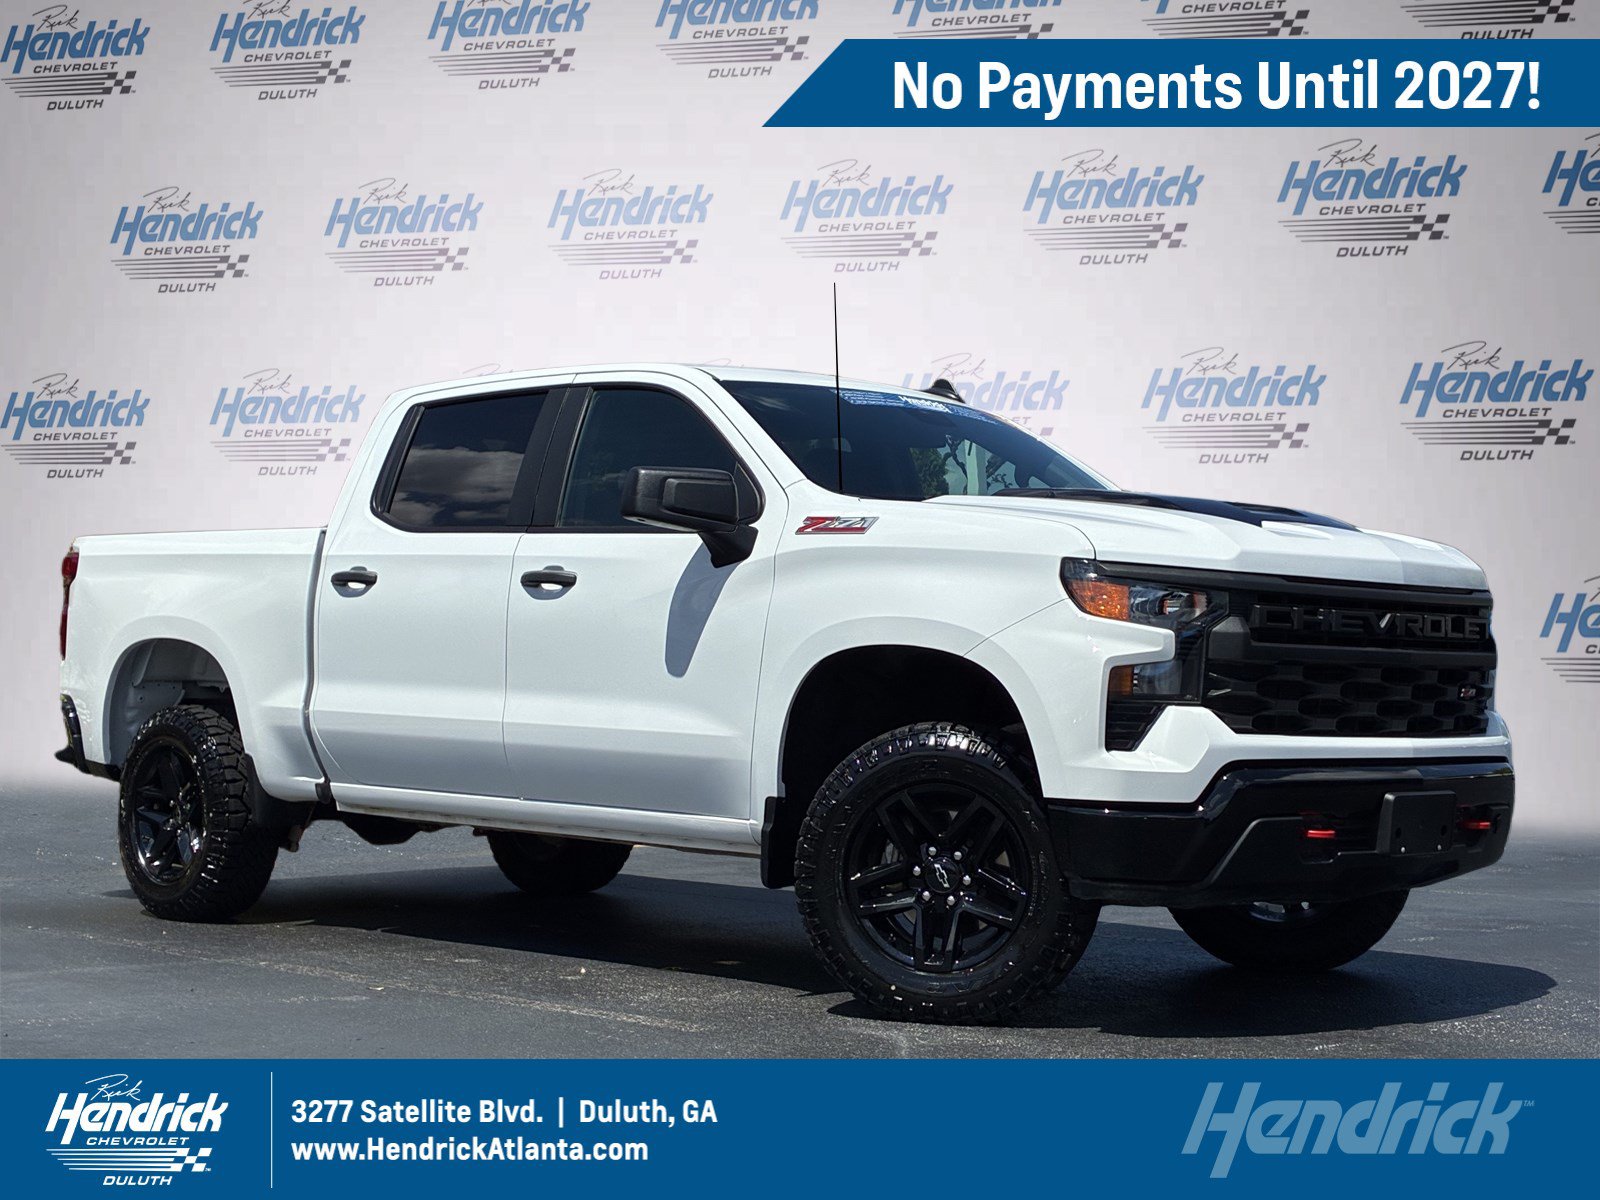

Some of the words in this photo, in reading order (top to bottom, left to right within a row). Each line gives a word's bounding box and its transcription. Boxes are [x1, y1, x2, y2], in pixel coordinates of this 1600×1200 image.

[1181, 0, 1287, 14] CHEVROLET
[427, 0, 590, 51] Hendrick
[931, 13, 1032, 27] CHEVROLET
[209, 6, 366, 63] Hendrick
[692, 26, 788, 40] CHEVROLET
[0, 18, 150, 74] Hendrick
[464, 38, 555, 51] CHEVROLET
[244, 50, 332, 63] CHEVROLET
[33, 61, 118, 74] CHEVROLET
[707, 65, 773, 79] DULUTH
[478, 77, 540, 90] DULUTH
[258, 88, 318, 101] DULUTH
[47, 99, 104, 111] DULUTH
[1277, 154, 1469, 215] Hendrick
[1023, 165, 1205, 224] Hendrick
[780, 174, 954, 232] Hendrick
[1319, 203, 1427, 216] CHEVROLET
[547, 184, 714, 241] Hendrick
[1062, 212, 1166, 225] CHEVROLET
[324, 192, 484, 248] Hendrick
[110, 201, 264, 256] Hendrick
[818, 221, 917, 233] CHEVROLET
[583, 229, 678, 241] CHEVROLET
[359, 237, 450, 248] CHEVROLET
[143, 245, 231, 256] CHEVROLET
[1336, 245, 1409, 258] DULUTH
[1079, 253, 1149, 266] DULUTH
[833, 260, 901, 273] DULUTH
[598, 268, 663, 280] DULUTH
[157, 282, 217, 294] DULUTH
[373, 276, 435, 287] DULUTH
[901, 370, 1070, 413] ndrick
[1141, 364, 1327, 422] Hendrick
[1399, 359, 1595, 418] Hendrick
[0, 389, 150, 440] Hendrick
[209, 385, 366, 437] Hendrick
[1182, 411, 1287, 422] CHEVROLET
[1442, 407, 1553, 419] CHEVROLET
[33, 431, 118, 441] CHEVROLET
[243, 428, 332, 438] CHEVROLET
[1198, 452, 1270, 464] DULUTH
[1459, 449, 1535, 461] DULUTH
[47, 468, 104, 479] DULUTH
[257, 465, 318, 476] DULUTH
